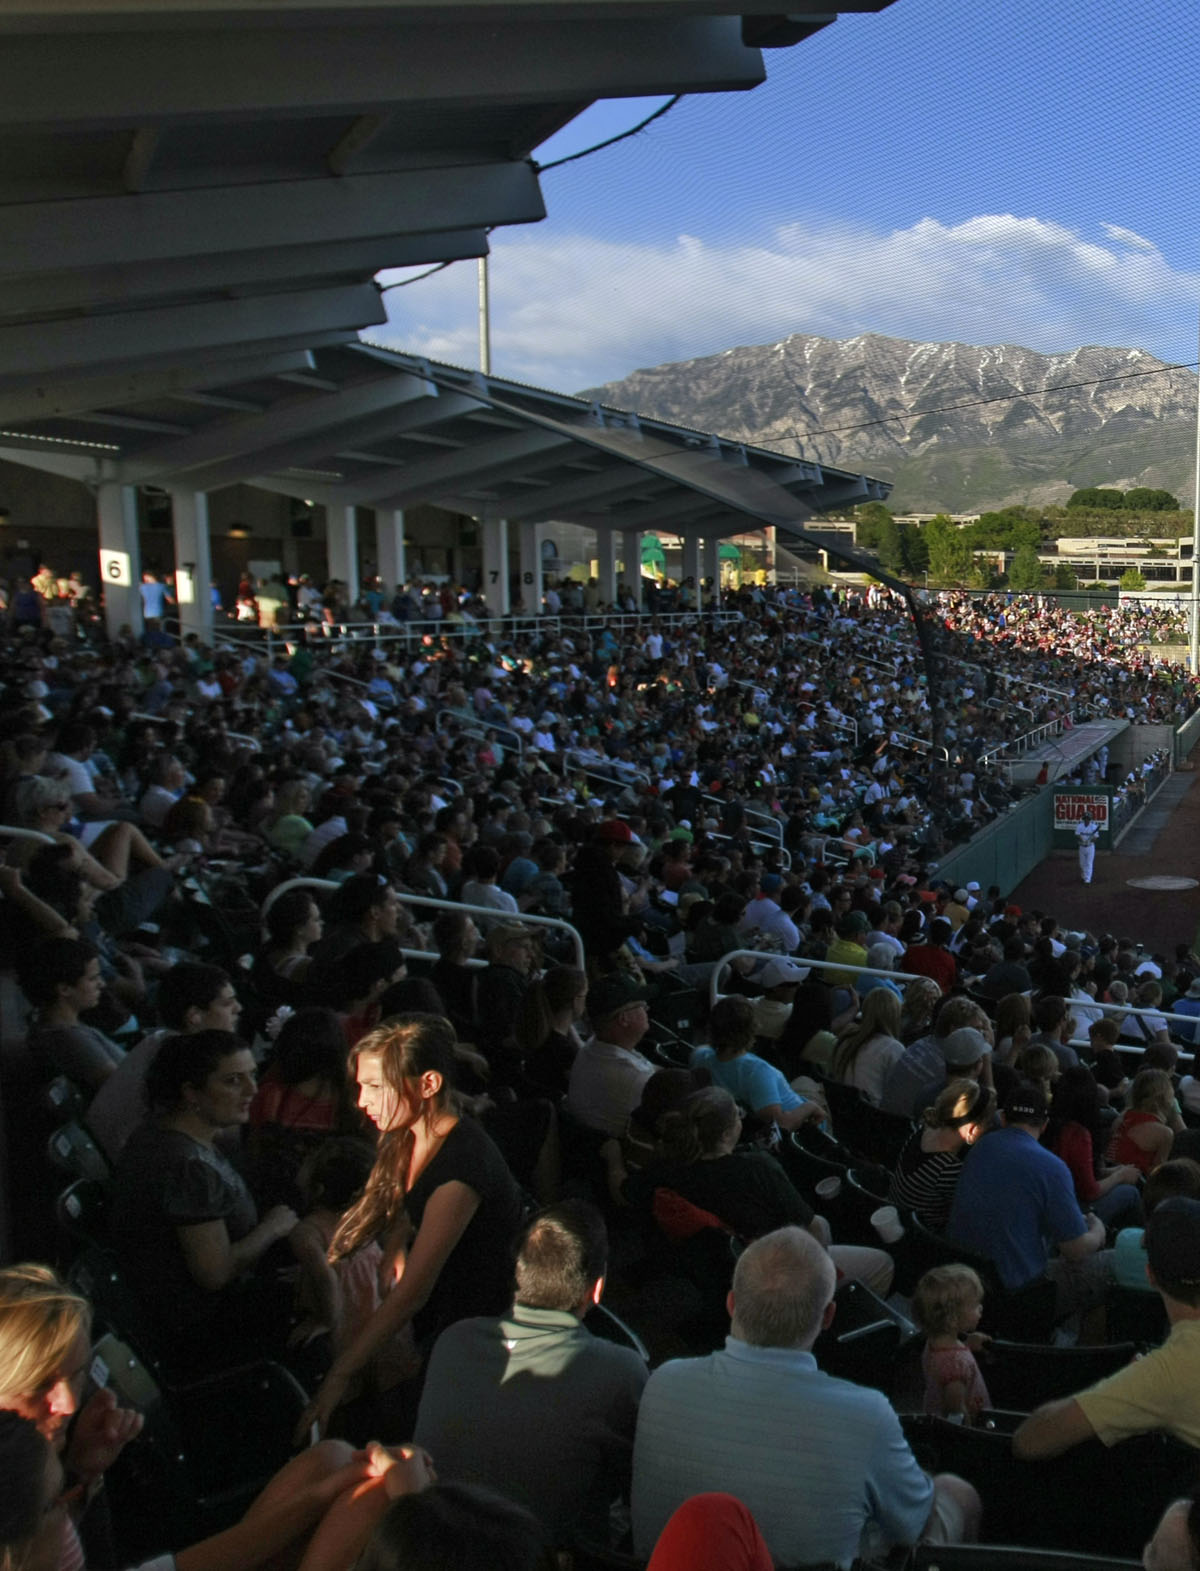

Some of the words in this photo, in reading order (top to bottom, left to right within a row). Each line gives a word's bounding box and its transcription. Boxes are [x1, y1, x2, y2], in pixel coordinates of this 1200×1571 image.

[109, 560, 121, 579] 6
[183, 562, 195, 580] 7
[488, 570, 499, 584] 7
[523, 571, 534, 585] 8
[1056, 796, 1095, 804] NATIONAL
[1056, 804, 1107, 821] GUARD
